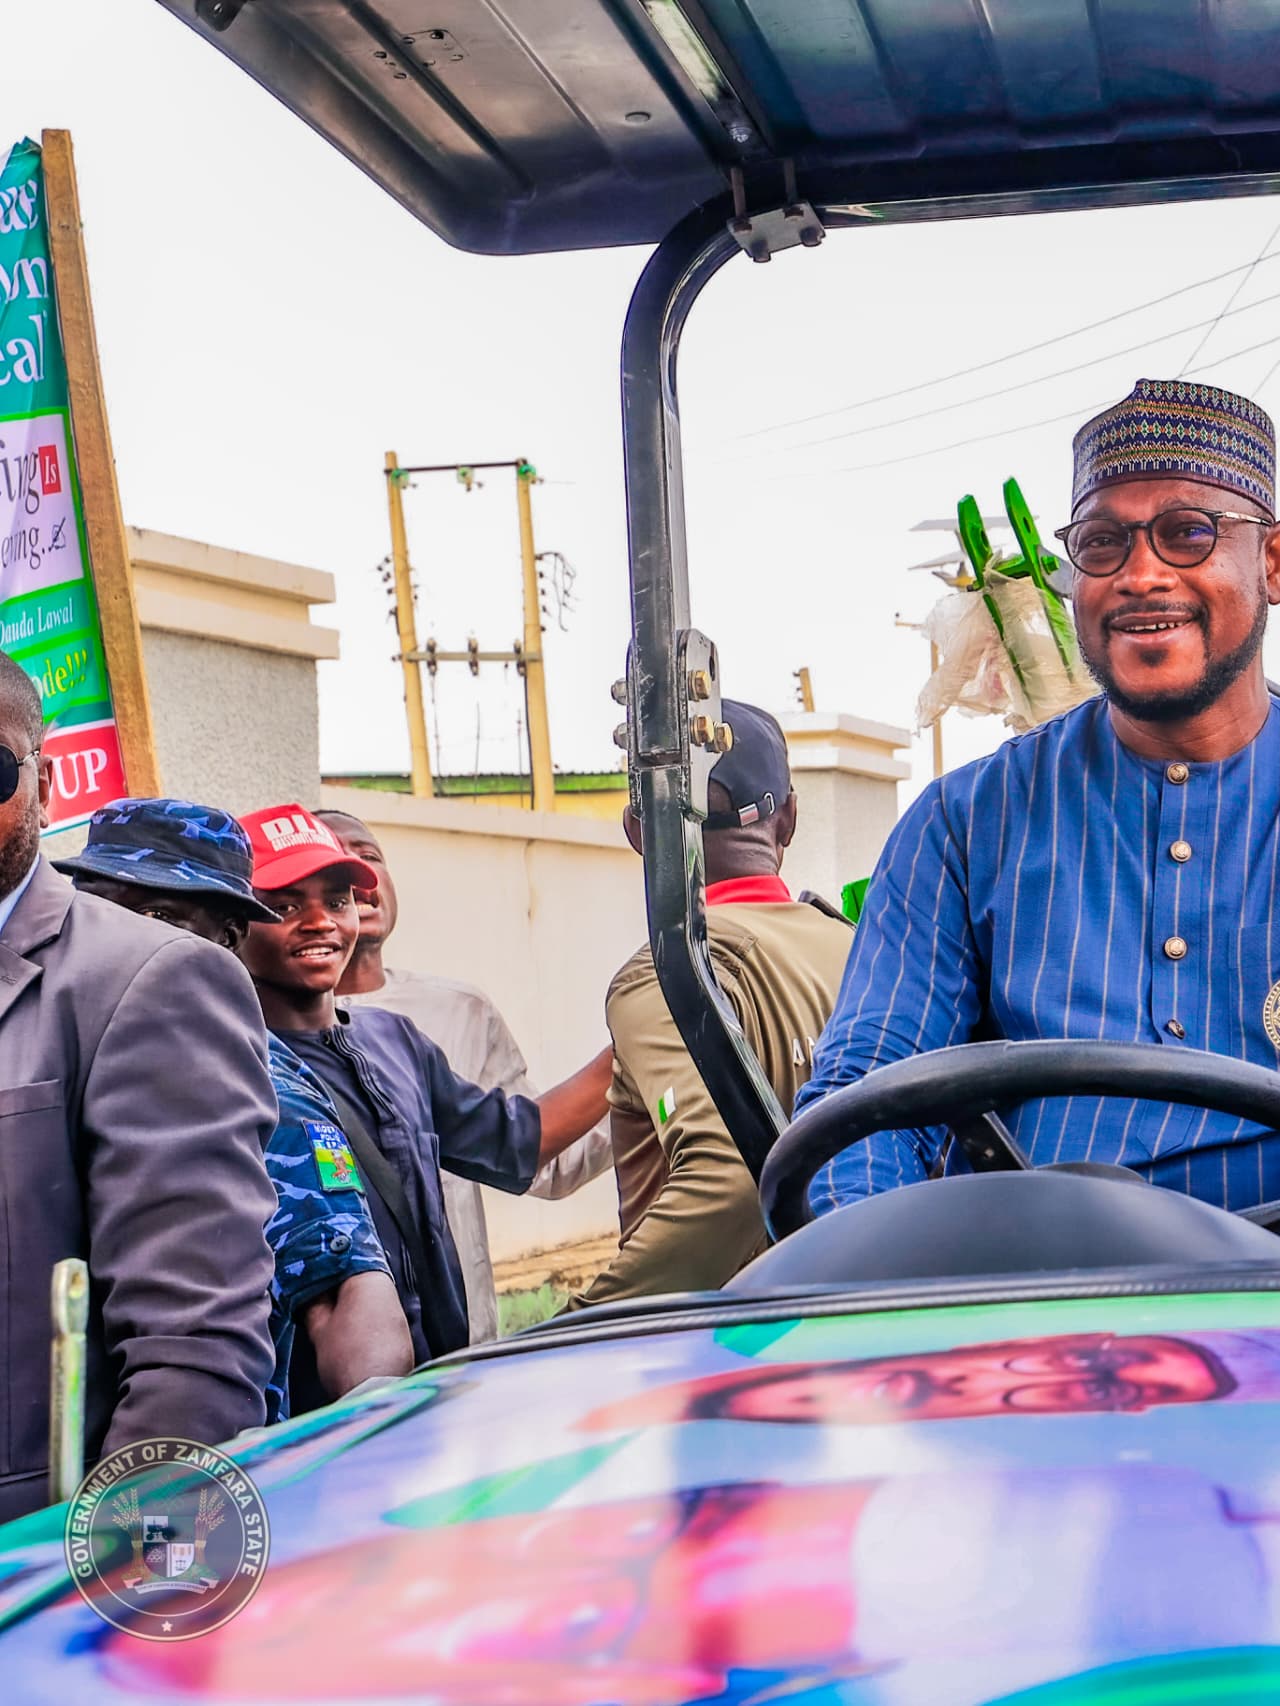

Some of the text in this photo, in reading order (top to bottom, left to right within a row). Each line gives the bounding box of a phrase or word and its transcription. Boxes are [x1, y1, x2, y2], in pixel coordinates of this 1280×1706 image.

[45, 455, 57, 486] Is
[0, 597, 73, 647] Dauda Lawal
